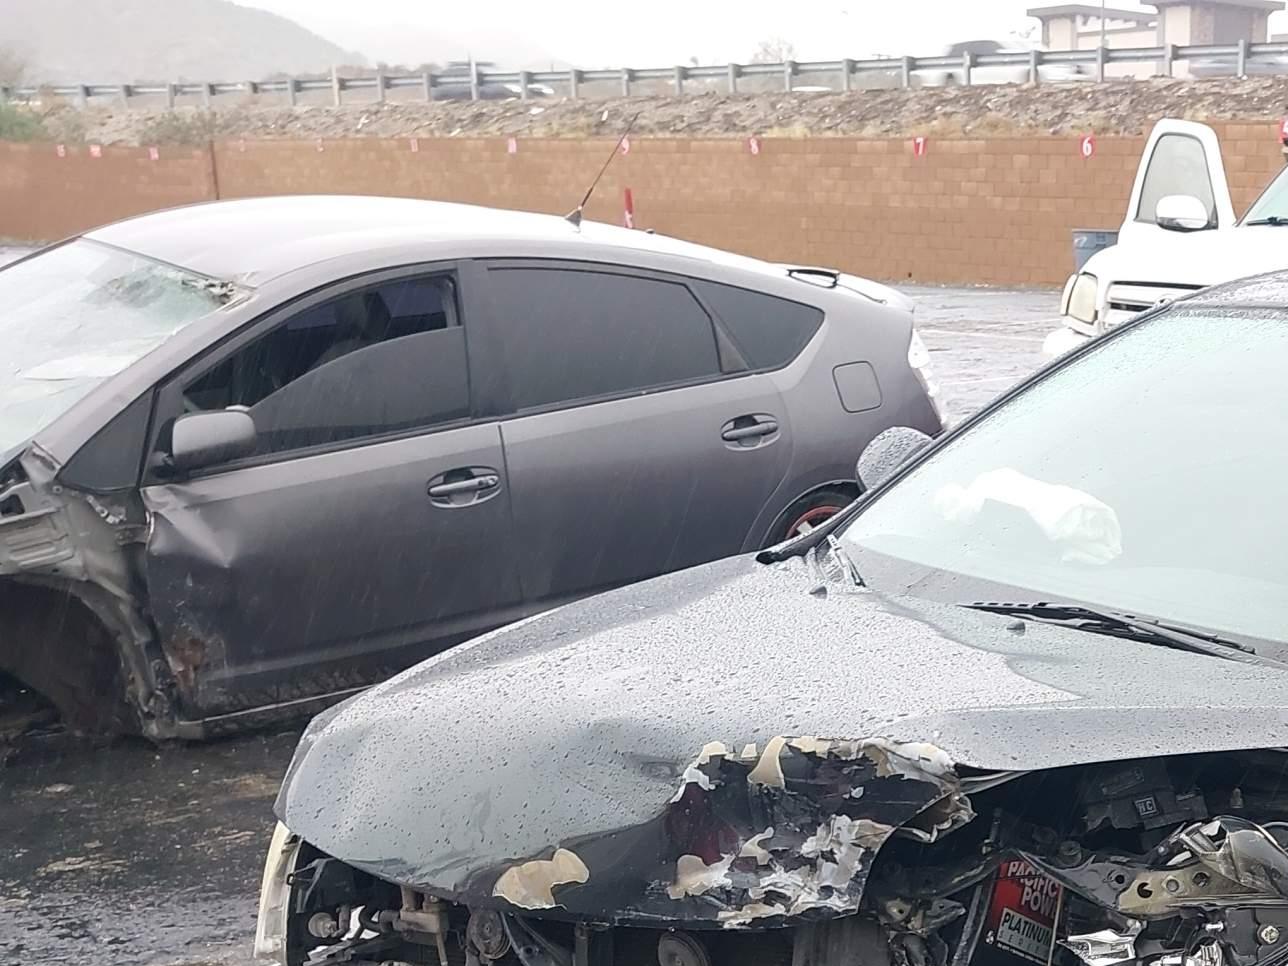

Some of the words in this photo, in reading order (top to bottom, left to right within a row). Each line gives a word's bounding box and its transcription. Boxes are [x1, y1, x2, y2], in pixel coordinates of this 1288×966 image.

[749, 138, 759, 155] 8
[915, 137, 924, 155] 7
[1082, 137, 1092, 156] 6
